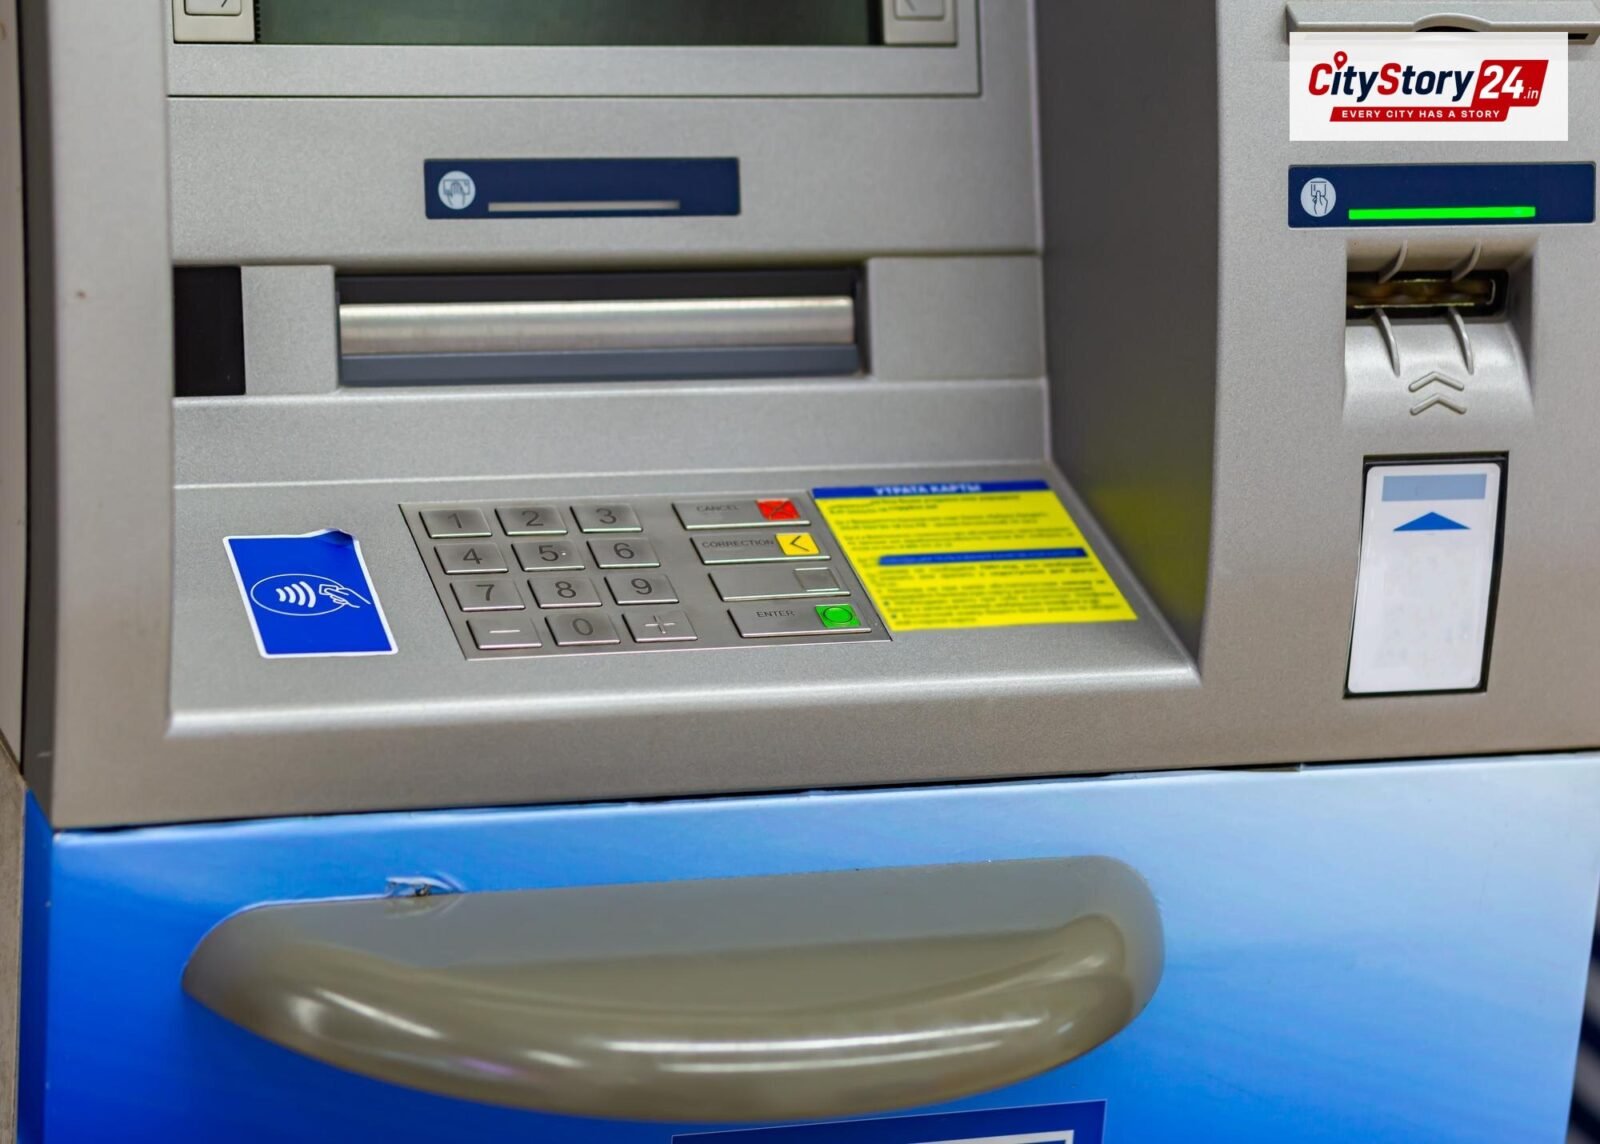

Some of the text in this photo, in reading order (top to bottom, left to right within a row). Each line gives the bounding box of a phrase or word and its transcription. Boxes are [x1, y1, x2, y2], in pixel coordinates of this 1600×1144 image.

[596, 508, 617, 524] 3
[696, 504, 739, 512] CANCEL
[447, 513, 462, 528] 1
[521, 510, 544, 527] 2
[613, 543, 635, 559] 6
[702, 539, 775, 548] CORRECTION
[463, 548, 483, 564] 4
[538, 545, 559, 562] 5
[476, 584, 495, 601] 7
[555, 581, 577, 598] 8
[631, 578, 652, 595] 9
[756, 610, 795, 618] ENTER
